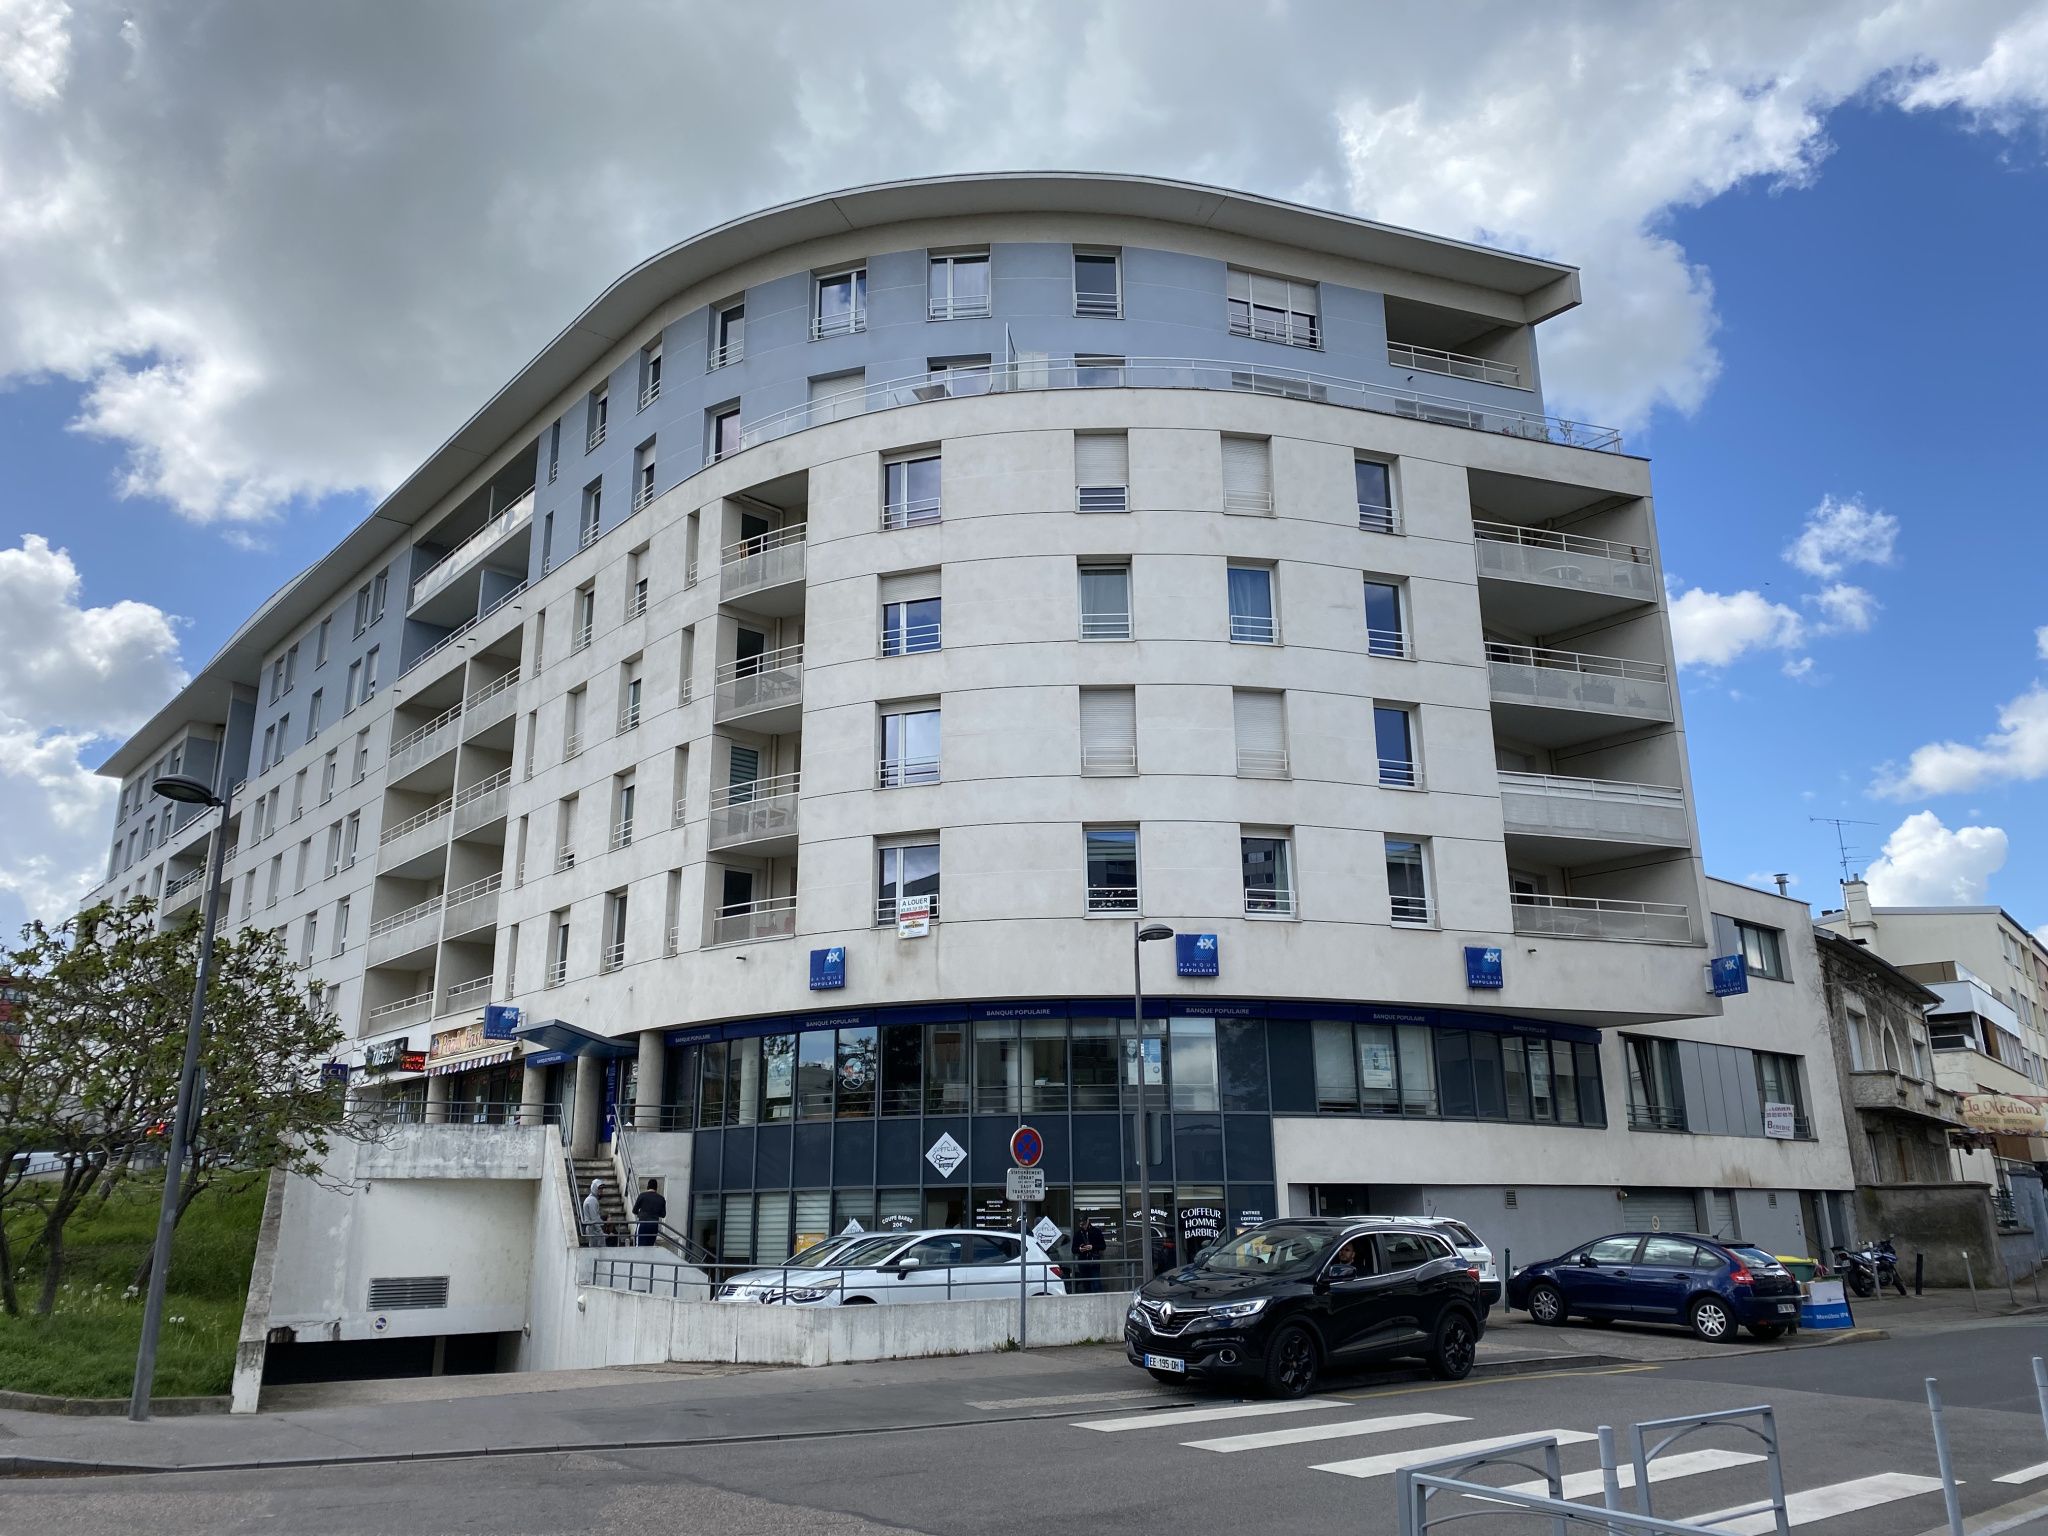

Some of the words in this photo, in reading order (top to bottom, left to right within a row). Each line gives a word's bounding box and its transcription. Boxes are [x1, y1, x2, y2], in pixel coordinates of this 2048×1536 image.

[908, 898, 928, 906] LOUER
[830, 1018, 860, 1026] POPULAIRE
[1964, 1100, 1983, 1116] La
[1984, 1101, 2034, 1116] Medina
[1968, 1116, 2000, 1124] RESTAURANT
[1150, 1208, 1168, 1217] BARBE
[1181, 1207, 1221, 1219] COIFFEUR
[881, 1215, 897, 1224] COUPE
[897, 1214, 913, 1223] BARBE
[1185, 1218, 1217, 1229] HOMME
[1184, 1228, 1219, 1239] BARBIER
